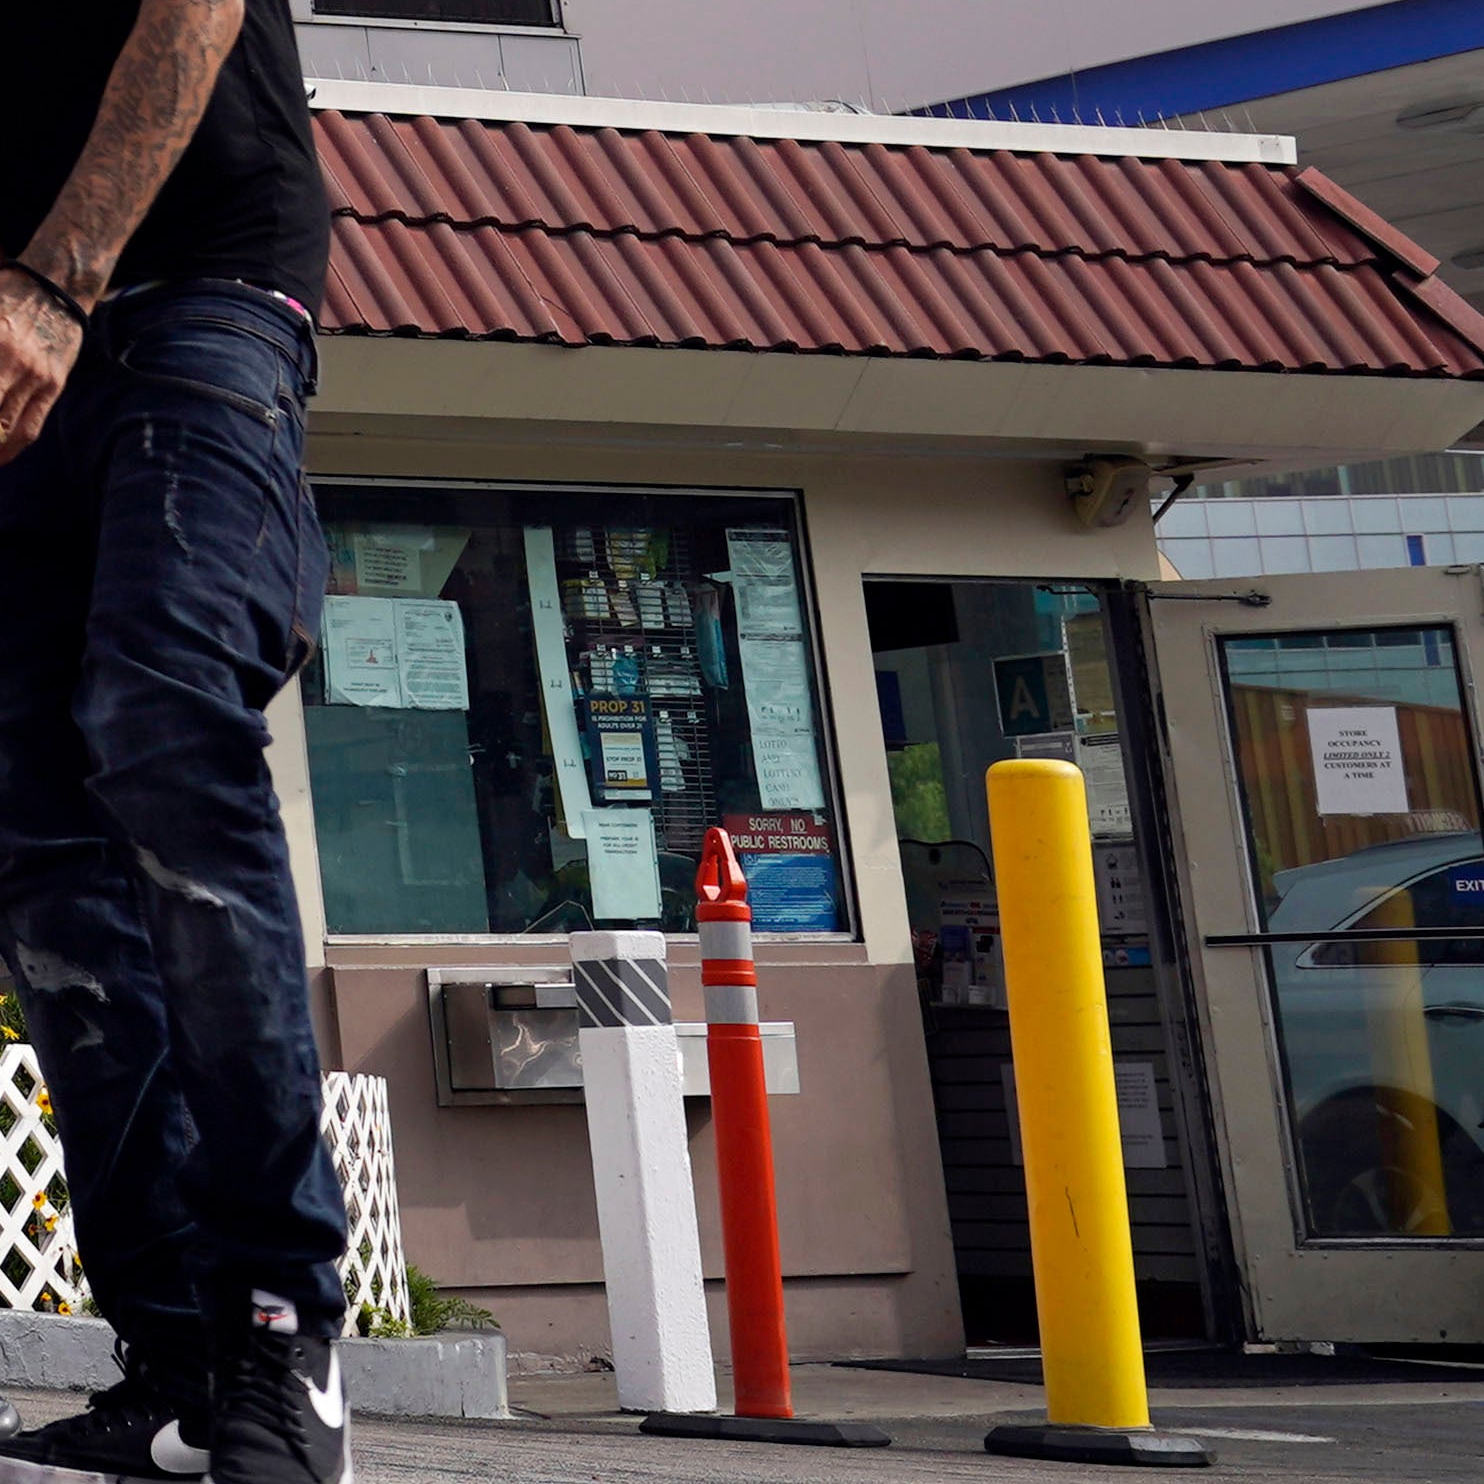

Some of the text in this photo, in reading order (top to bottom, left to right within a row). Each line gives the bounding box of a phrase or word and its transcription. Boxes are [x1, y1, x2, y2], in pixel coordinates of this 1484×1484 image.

[590, 700, 646, 713] PROP 31
[759, 739, 787, 749] LOTTO
[1323, 752, 1359, 760] LIMITED
[1361, 752, 1385, 760] ONLY
[748, 817, 807, 833] SORRY, NO
[732, 835, 829, 850] PUBLIC RESTROOMS
